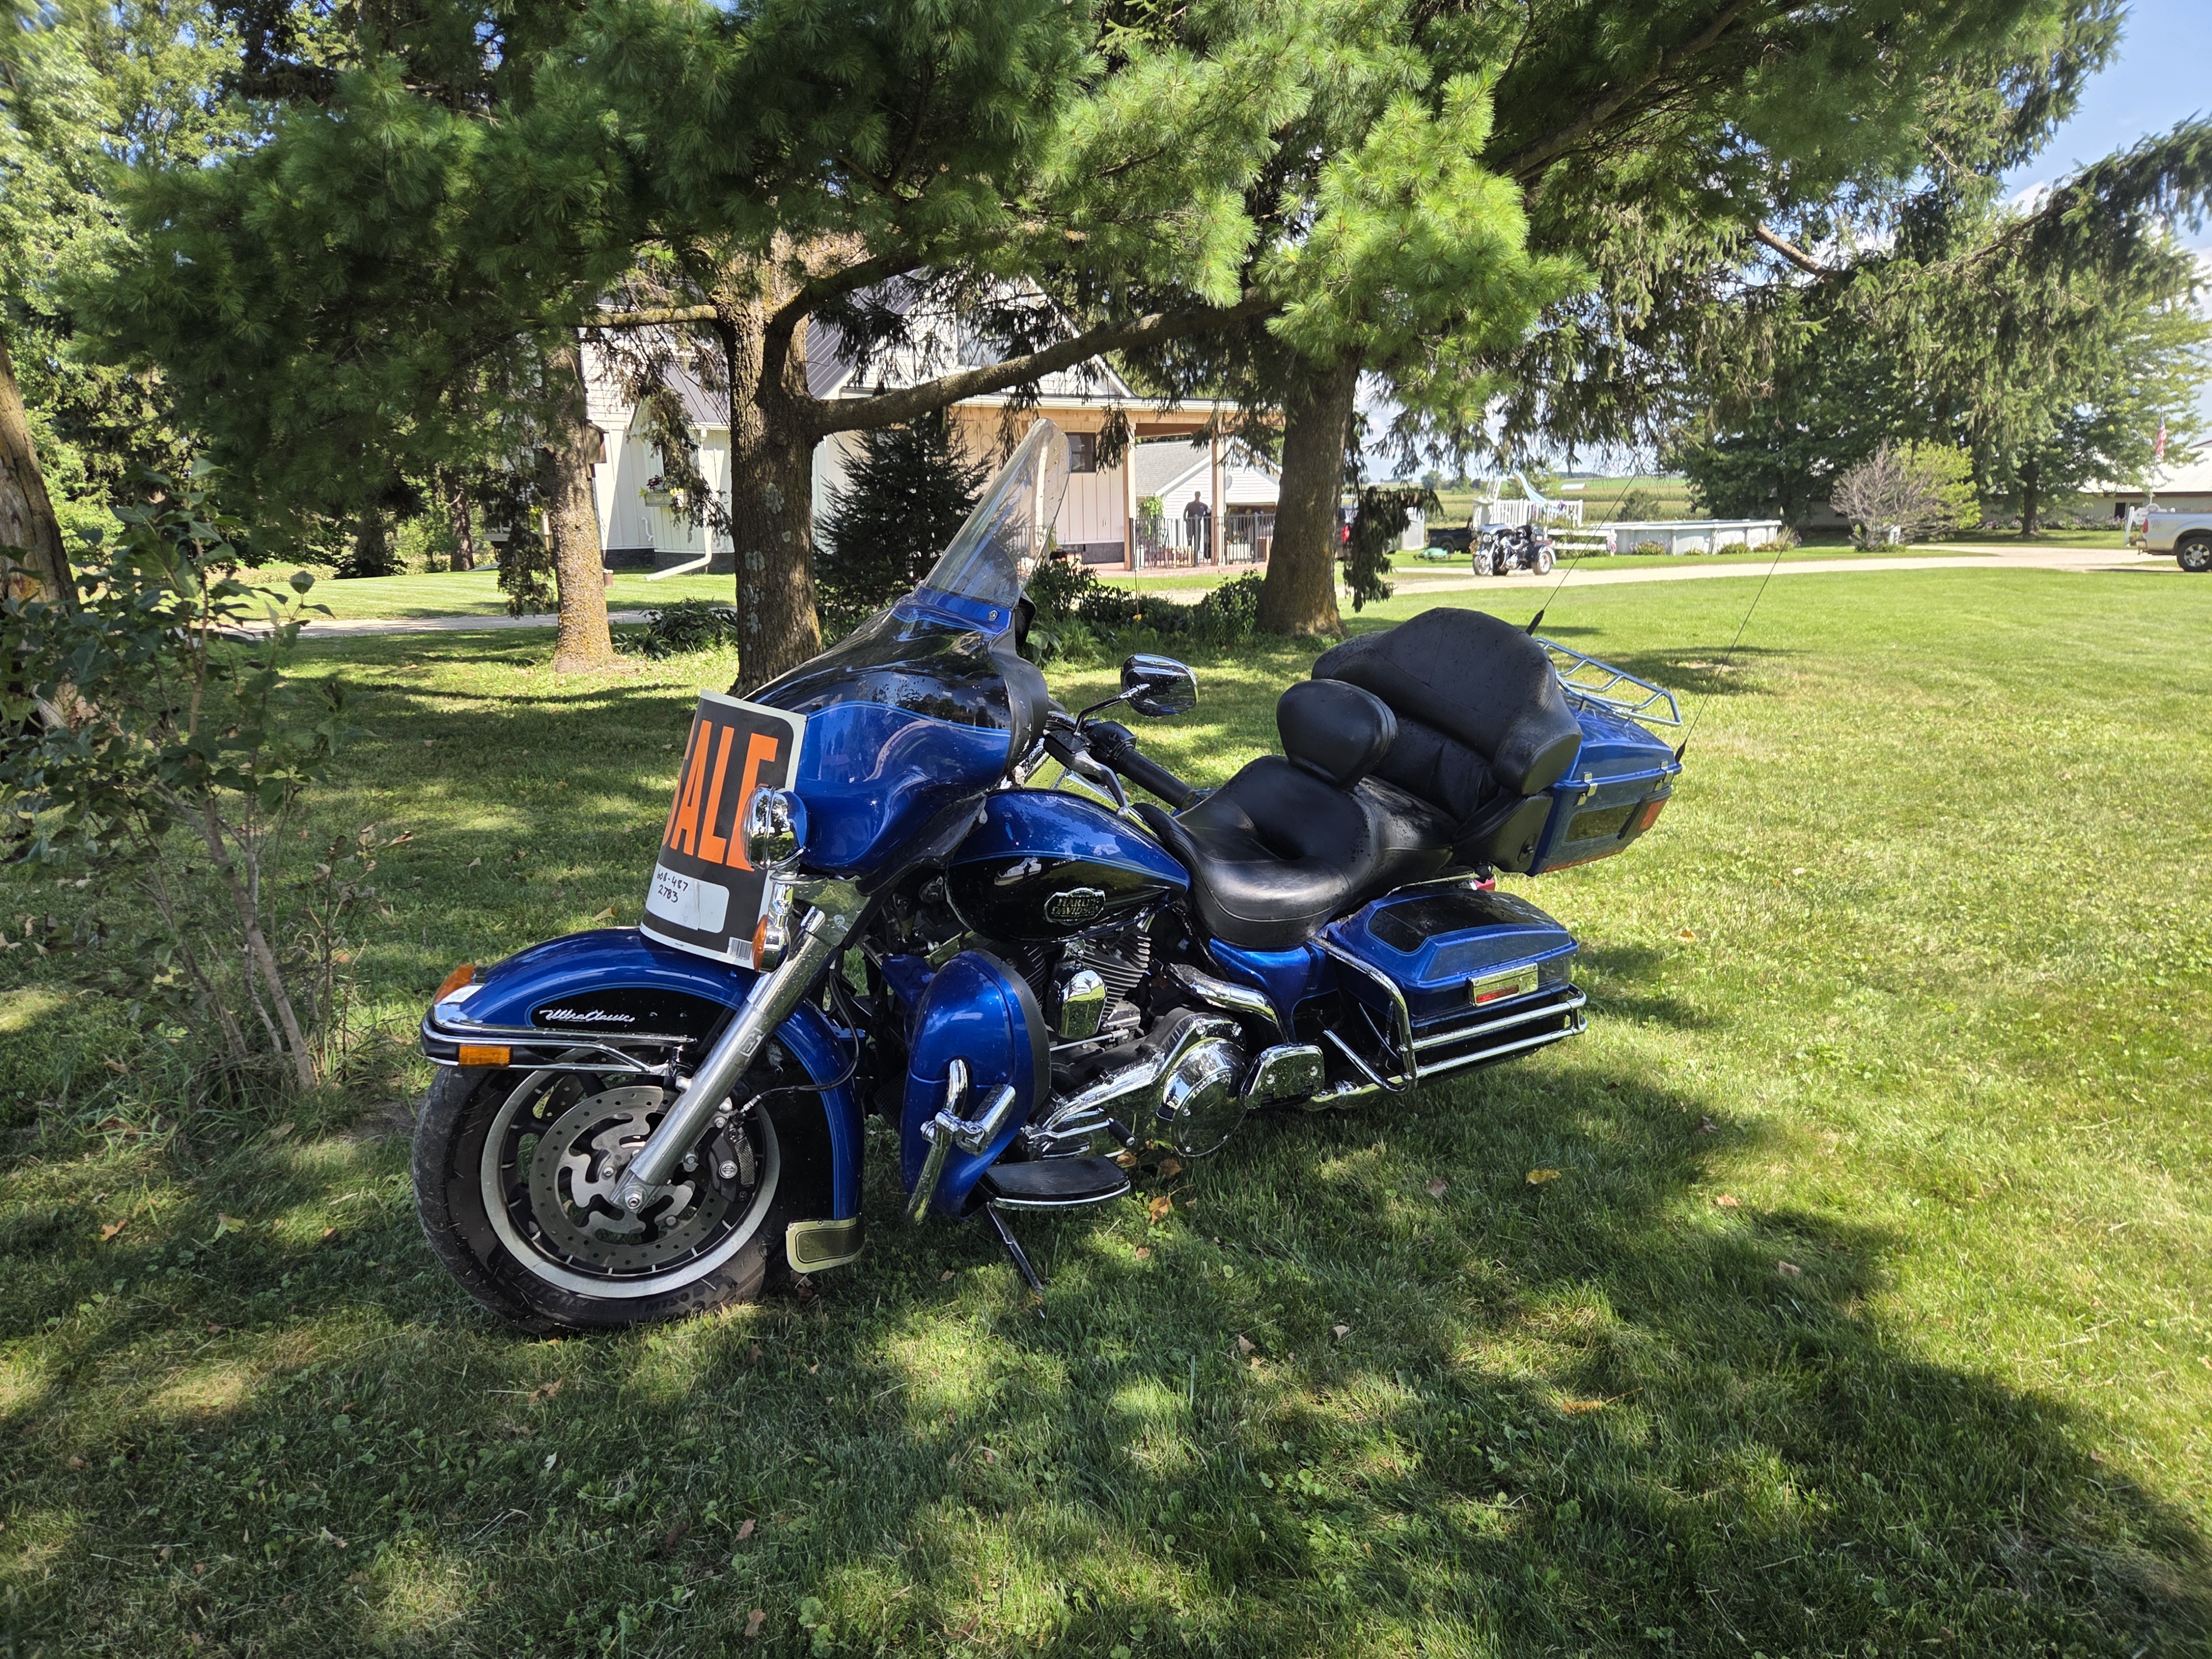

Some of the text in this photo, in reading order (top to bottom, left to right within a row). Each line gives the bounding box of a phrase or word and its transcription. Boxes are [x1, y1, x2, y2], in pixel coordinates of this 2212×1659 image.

[662, 713, 779, 872] ALE
[656, 868, 688, 891] 608-487
[658, 884, 679, 902] 2783
